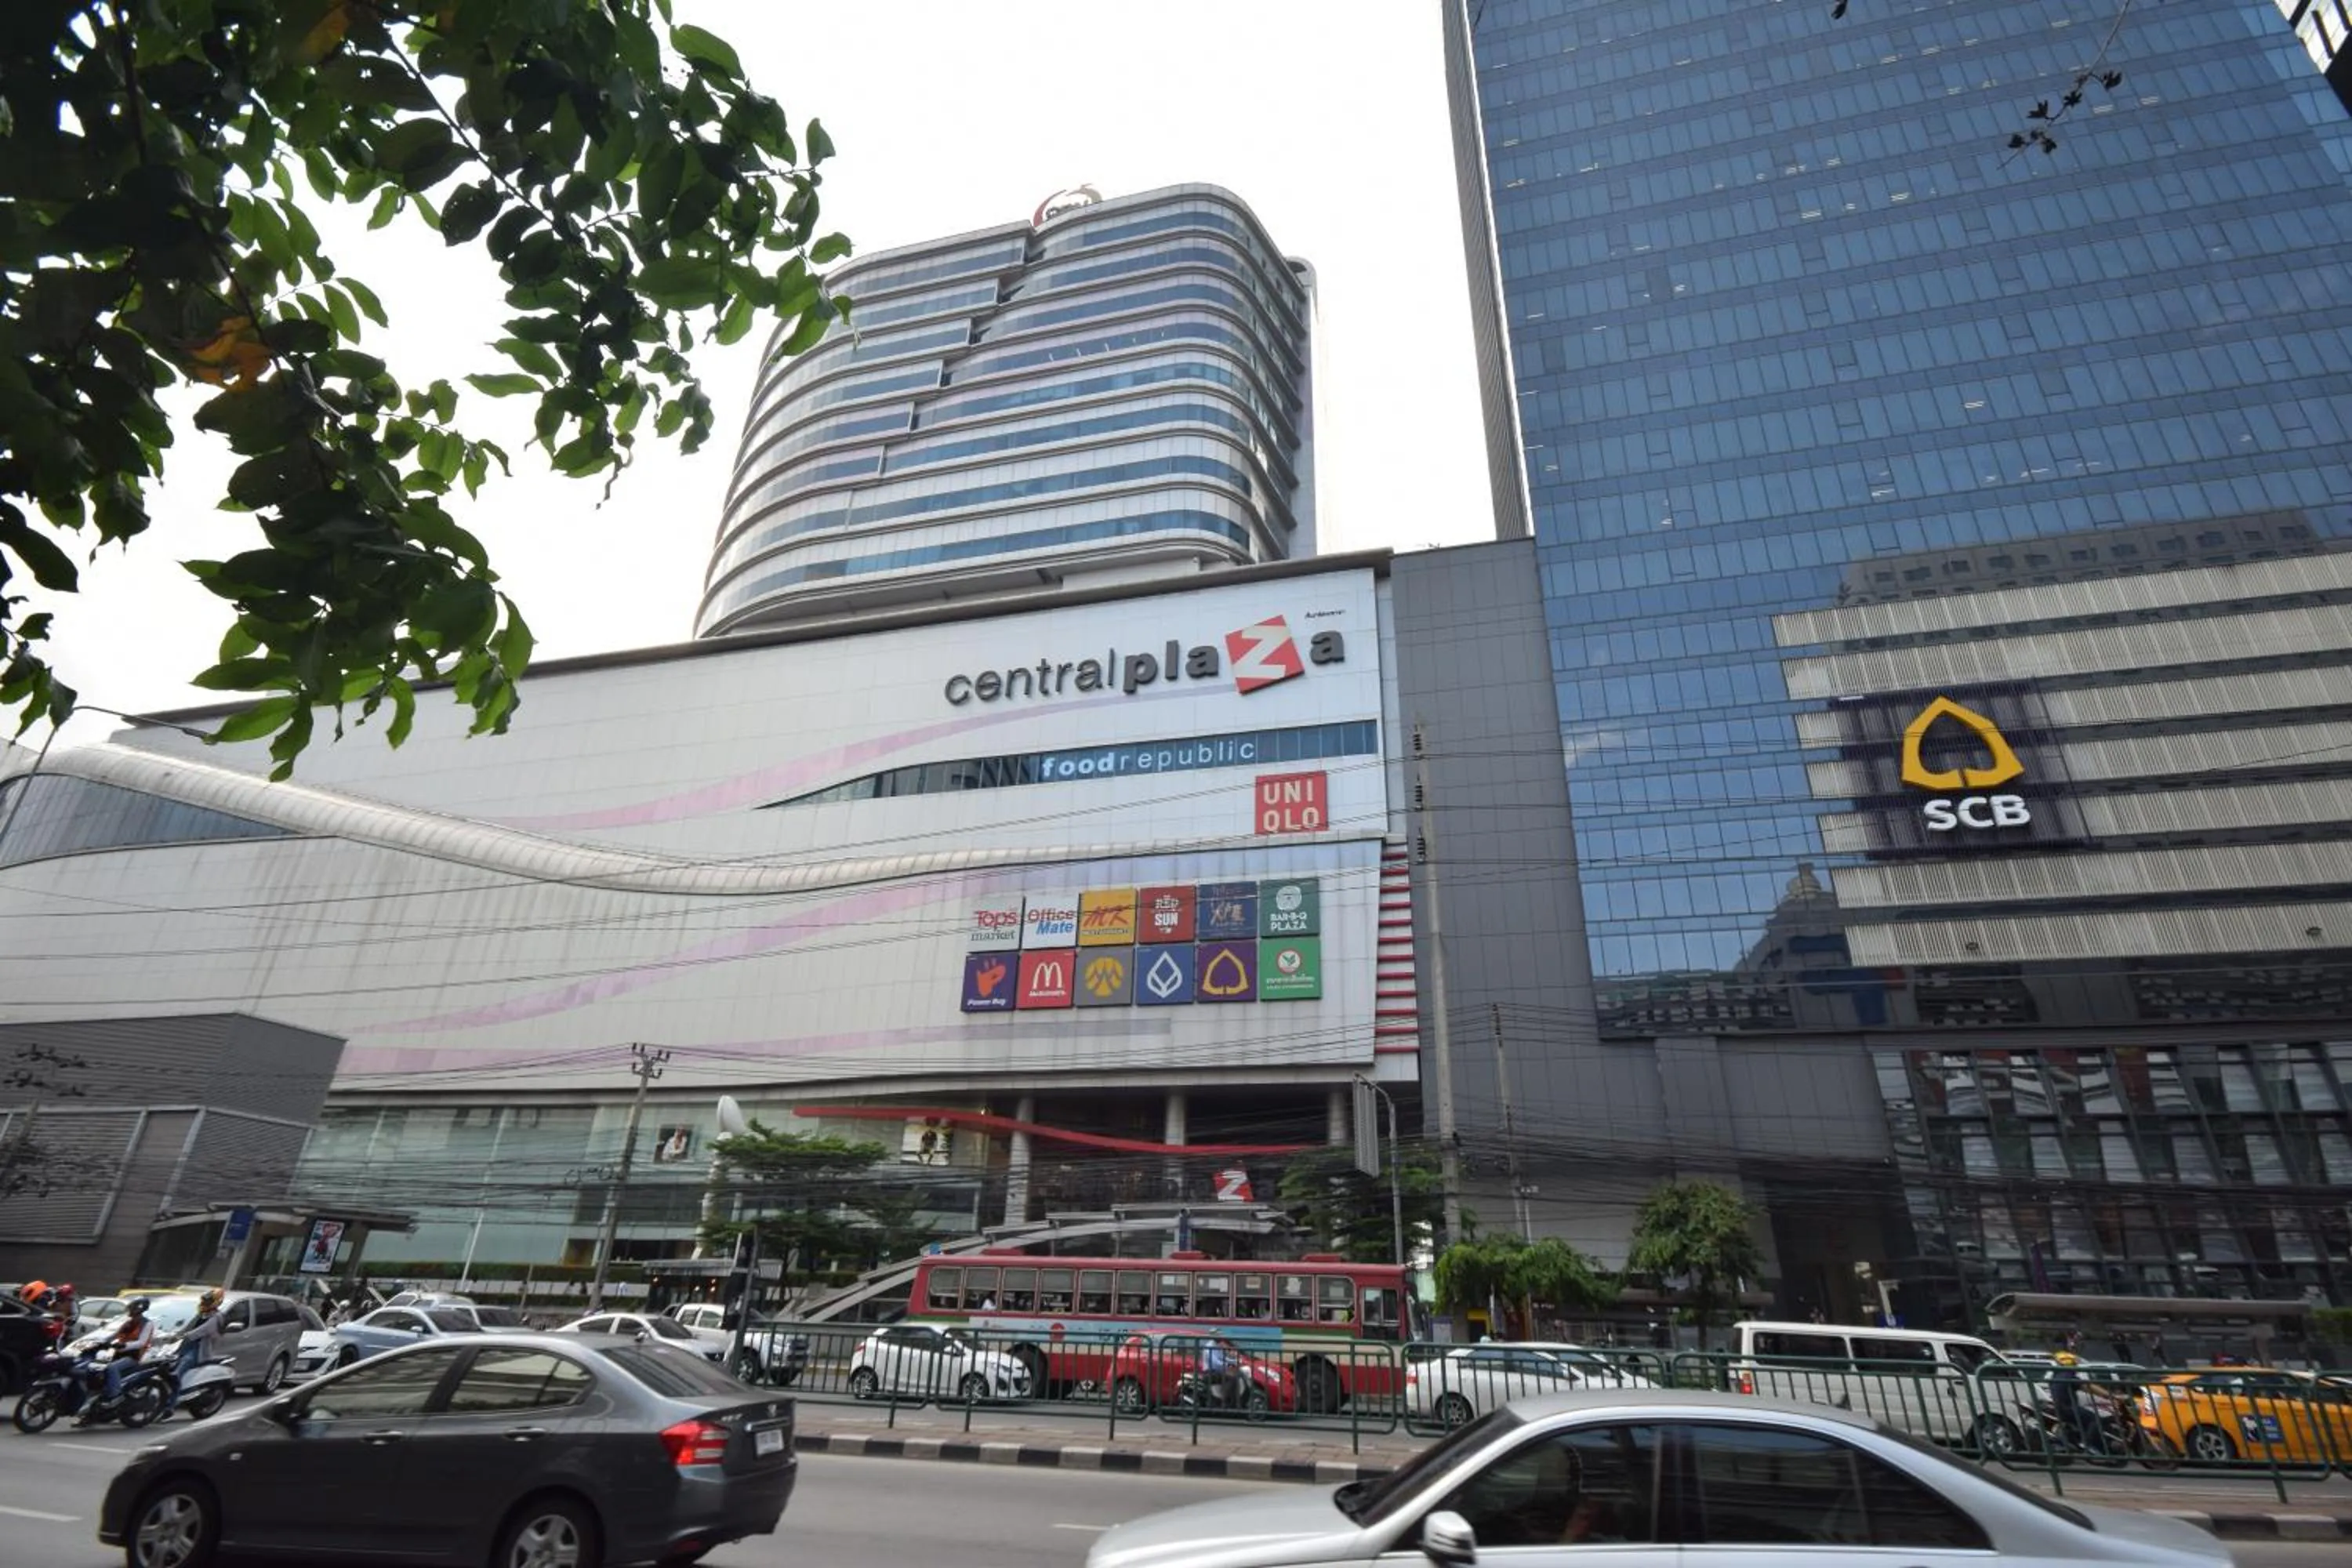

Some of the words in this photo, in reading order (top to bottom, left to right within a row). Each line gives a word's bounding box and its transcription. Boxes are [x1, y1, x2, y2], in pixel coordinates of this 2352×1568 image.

[1263, 778, 1314, 804] UNI
[1263, 806, 1319, 833] QLO
[1923, 793, 2031, 832] SCB
[978, 909, 1017, 930] Tops
[1028, 908, 1075, 924] Office
[1154, 912, 1178, 926] SUN
[1036, 920, 1073, 935] Mate
[1270, 920, 1308, 931] PLAZA
